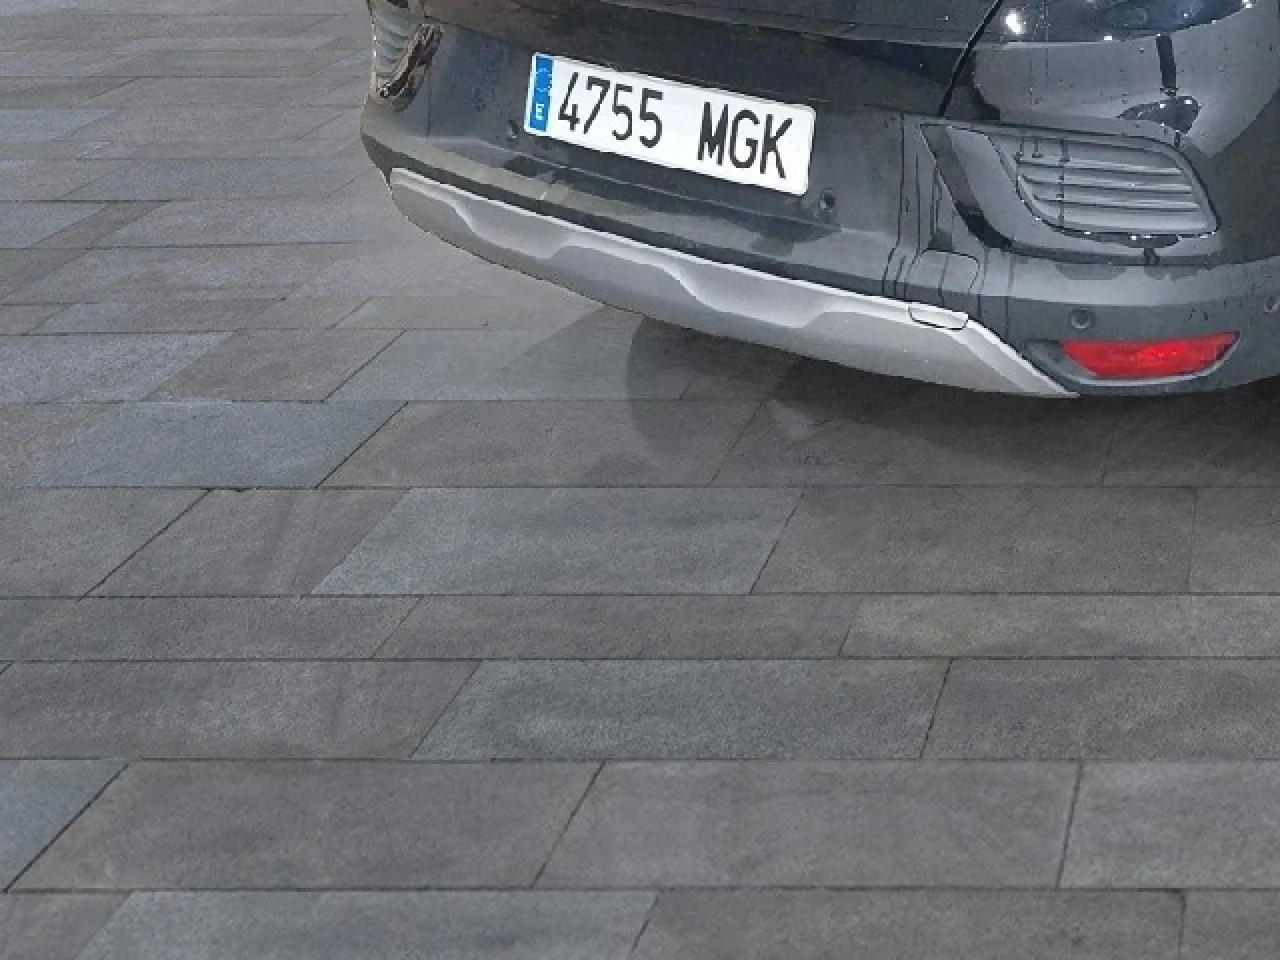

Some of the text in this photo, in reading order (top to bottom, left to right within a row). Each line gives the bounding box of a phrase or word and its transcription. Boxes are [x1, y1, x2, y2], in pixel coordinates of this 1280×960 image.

[534, 101, 545, 122] E
[557, 71, 793, 179] 4755 MGK
